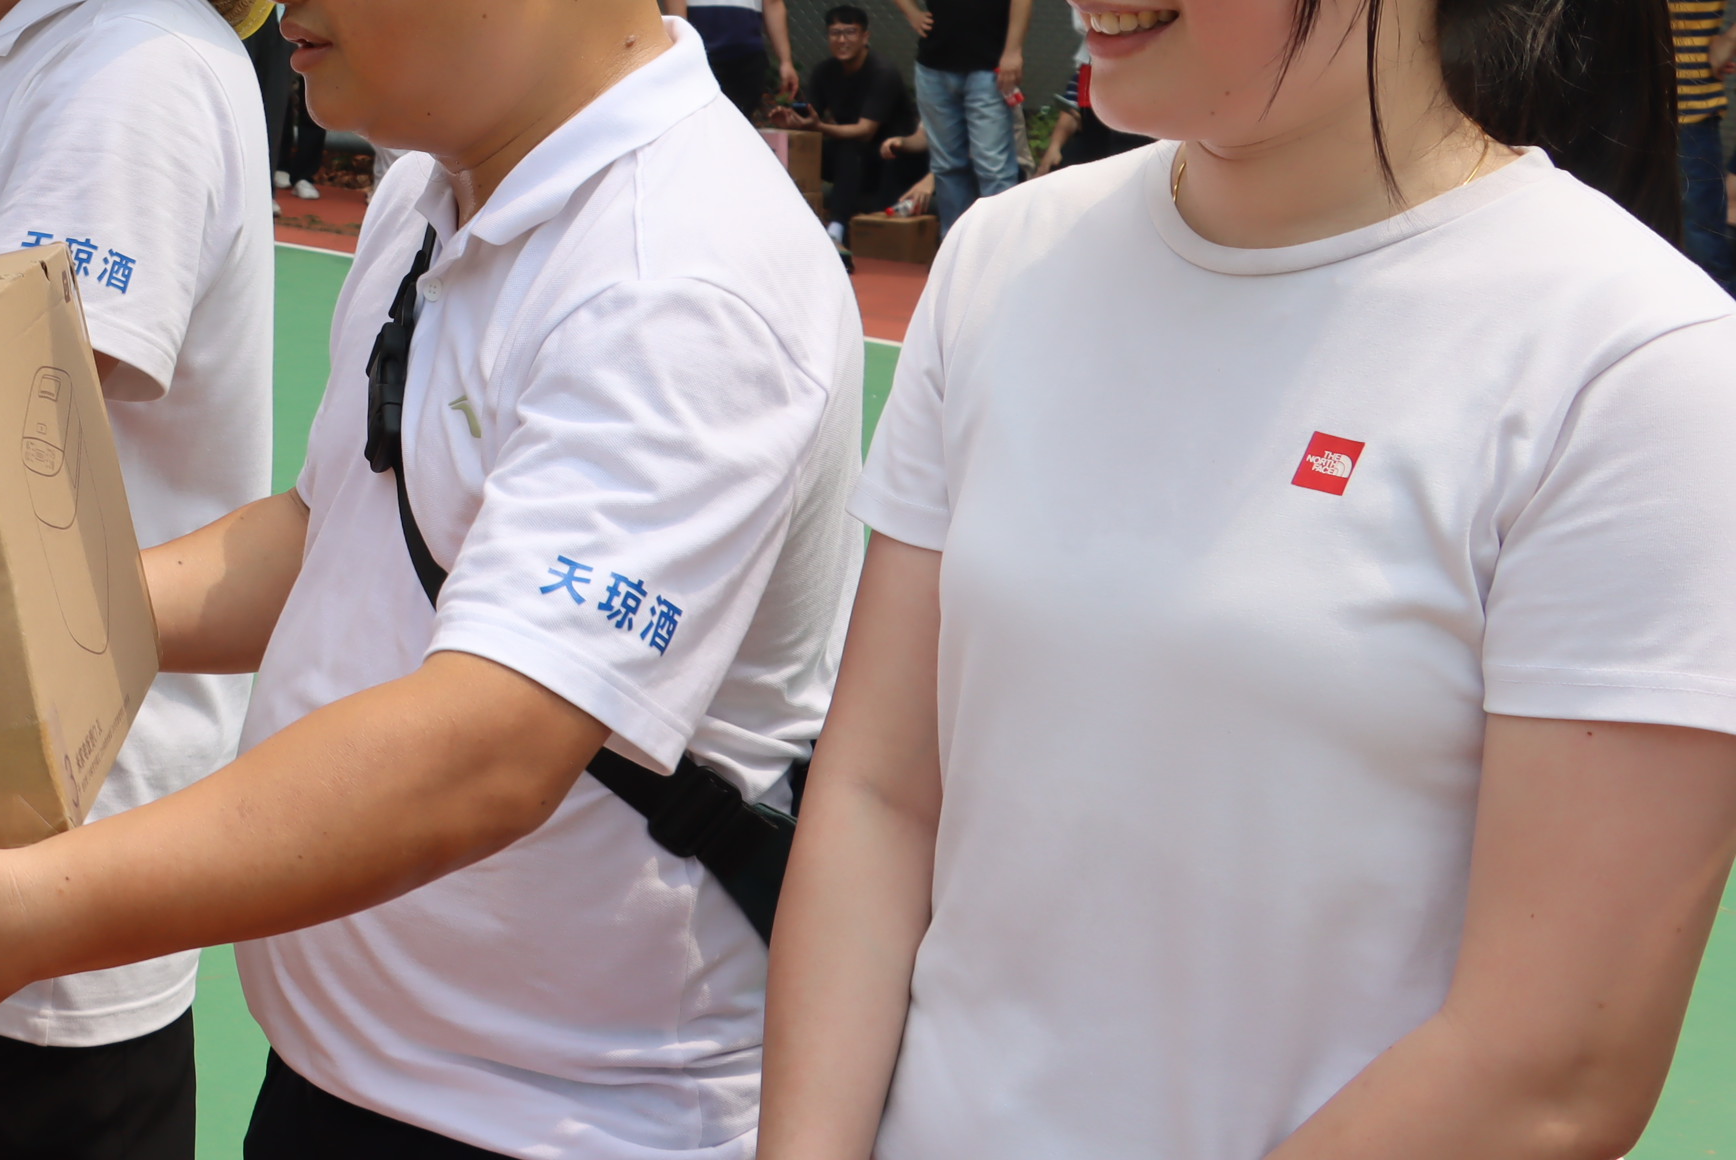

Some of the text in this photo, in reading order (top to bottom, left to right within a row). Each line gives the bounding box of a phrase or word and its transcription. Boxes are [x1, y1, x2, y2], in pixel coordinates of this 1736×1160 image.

[1306, 454, 1338, 468] NORTH
[1324, 450, 1342, 461] THE
[1311, 462, 1335, 476] FACE
[539, 554, 683, 657] 天琼酒
